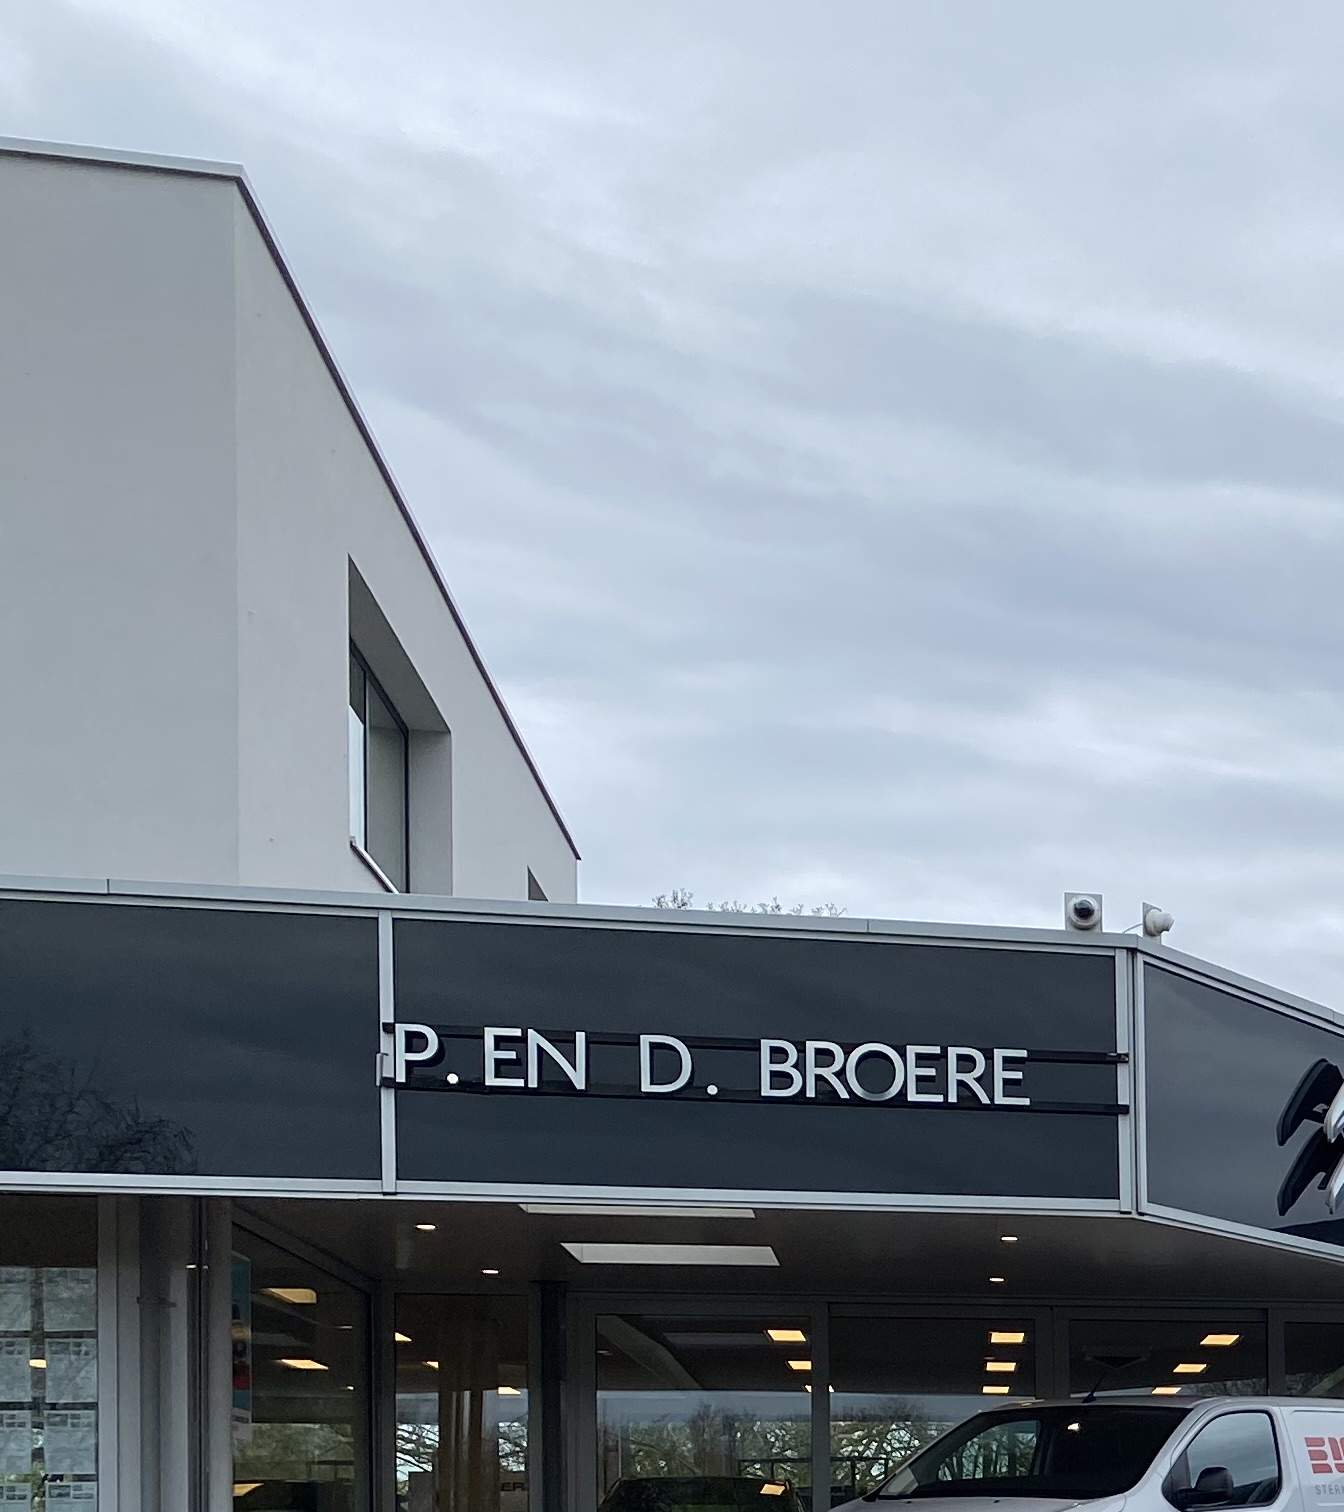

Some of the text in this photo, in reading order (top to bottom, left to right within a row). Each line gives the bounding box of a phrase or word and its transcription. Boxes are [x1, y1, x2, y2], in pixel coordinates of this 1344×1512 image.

[484, 1026, 587, 1090] EN
[639, 1034, 719, 1096] D.
[760, 1038, 1031, 1106] BROERE
